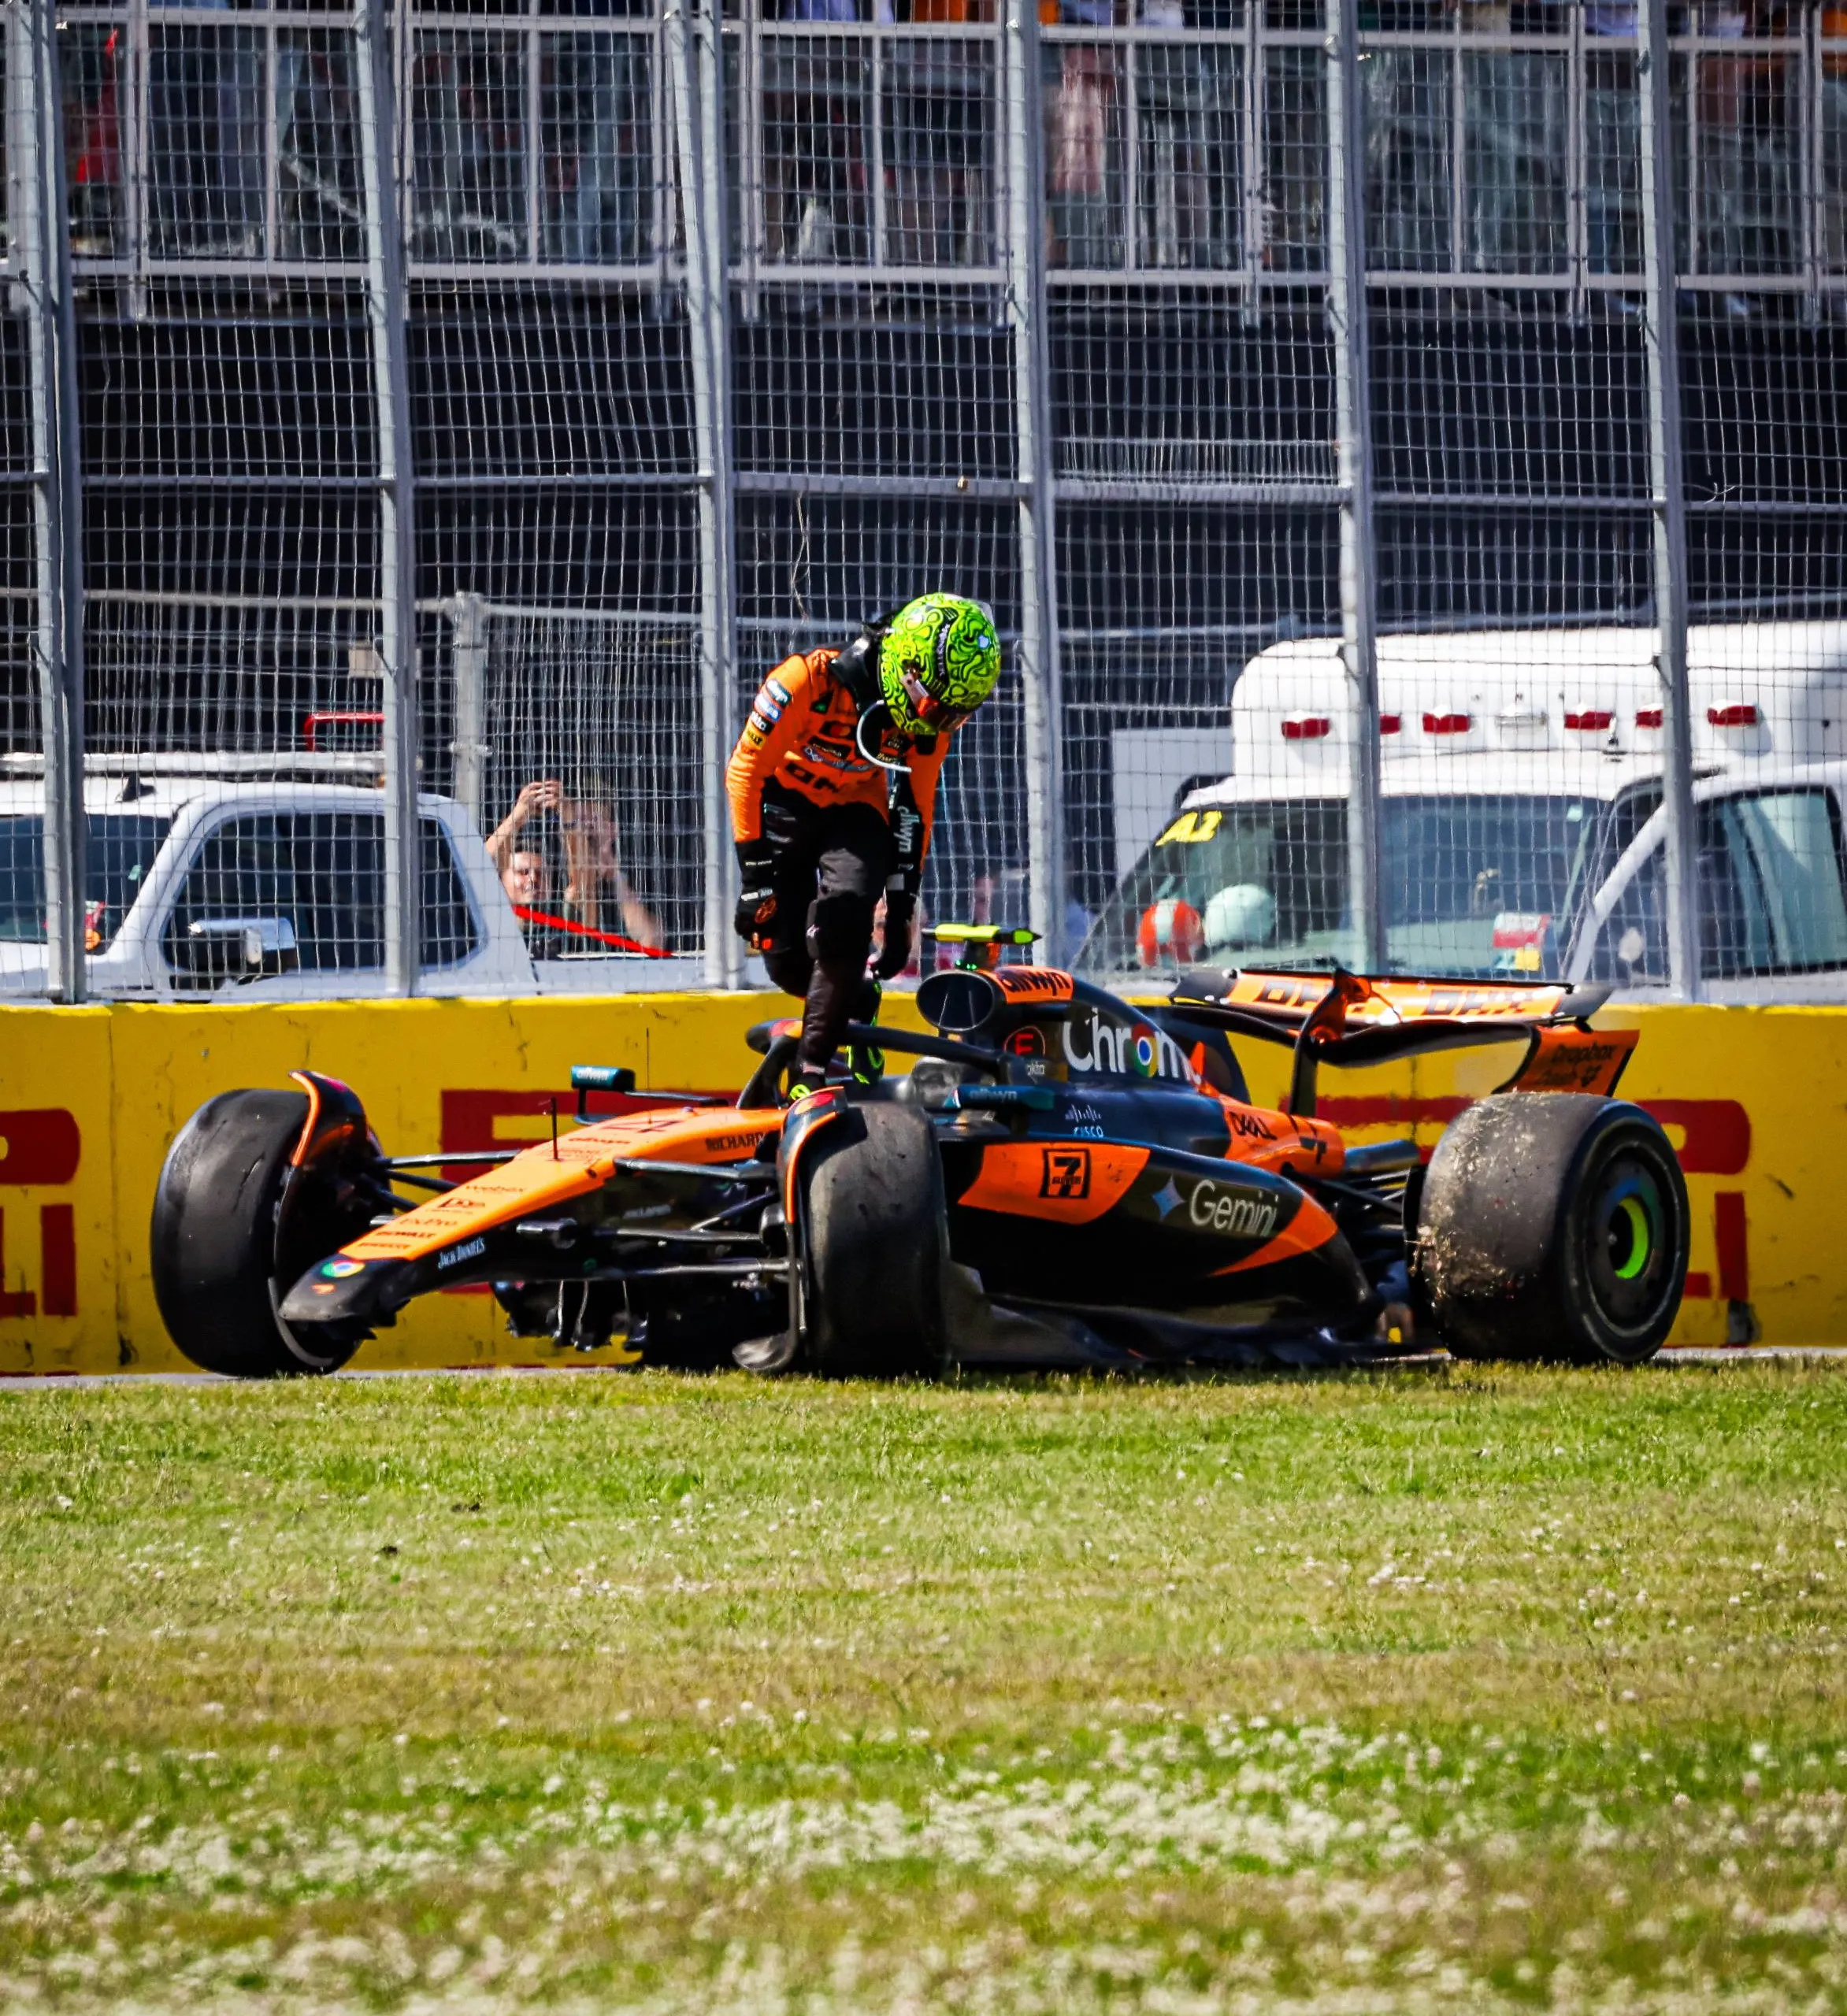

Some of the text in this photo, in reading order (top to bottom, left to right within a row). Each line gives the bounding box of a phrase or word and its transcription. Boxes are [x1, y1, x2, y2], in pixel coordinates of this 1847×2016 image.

[996, 969, 1071, 996] allwyn
[1063, 1007, 1201, 1085] Chrom
[1189, 1180, 1279, 1237] Gemini
